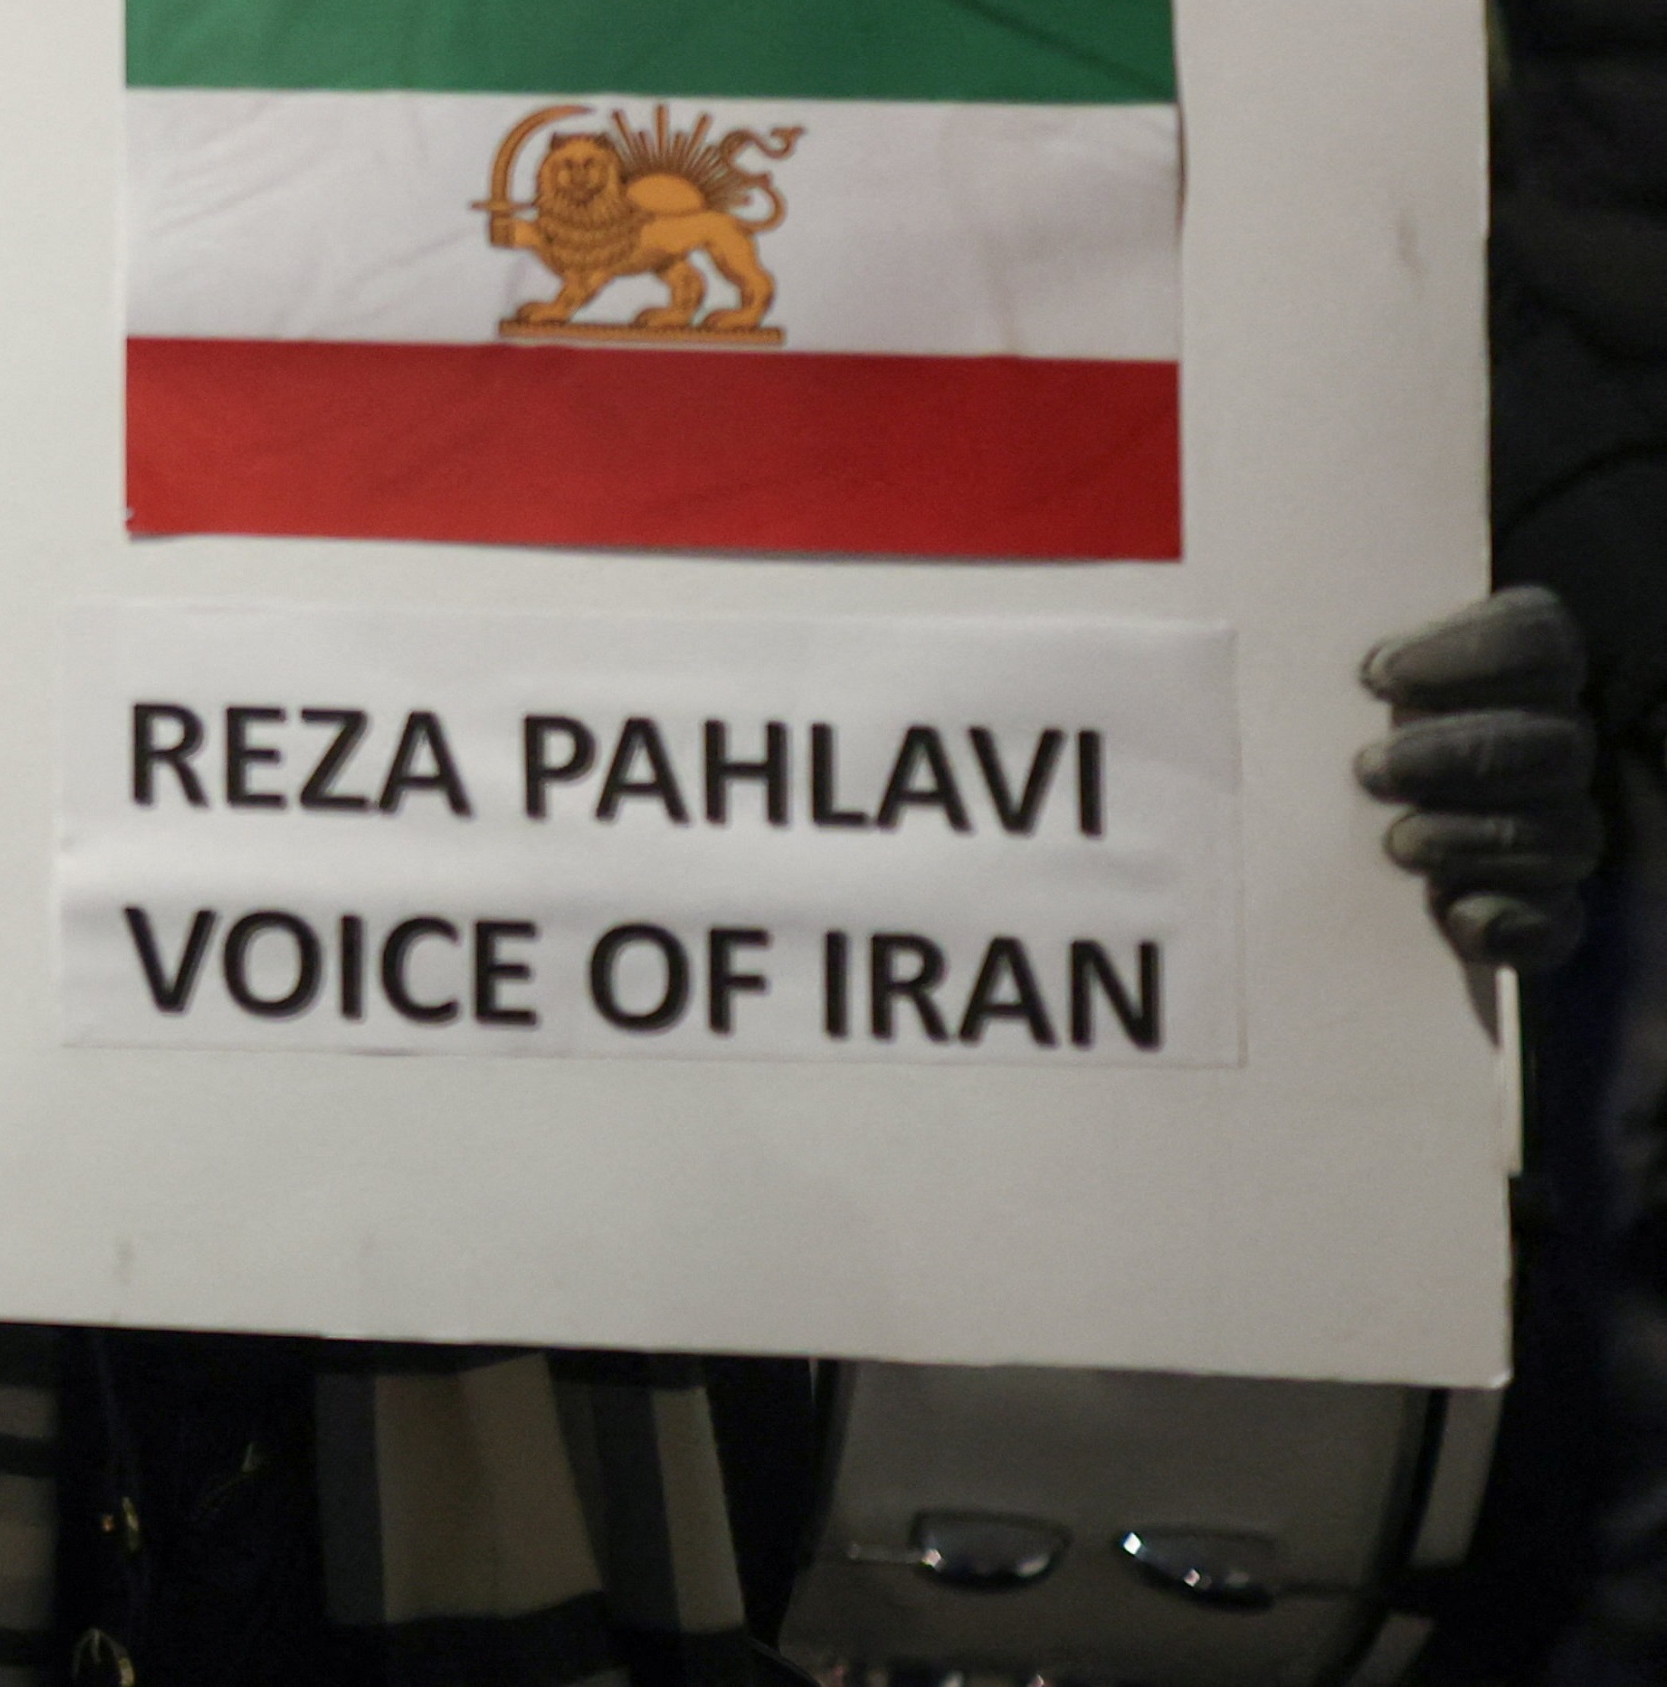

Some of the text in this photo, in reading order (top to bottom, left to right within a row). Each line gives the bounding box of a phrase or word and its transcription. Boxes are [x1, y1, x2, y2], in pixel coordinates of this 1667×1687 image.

[130, 702, 1105, 838] REZA PAHLAVI
[121, 906, 1164, 1054] VOICE OF IRAN
